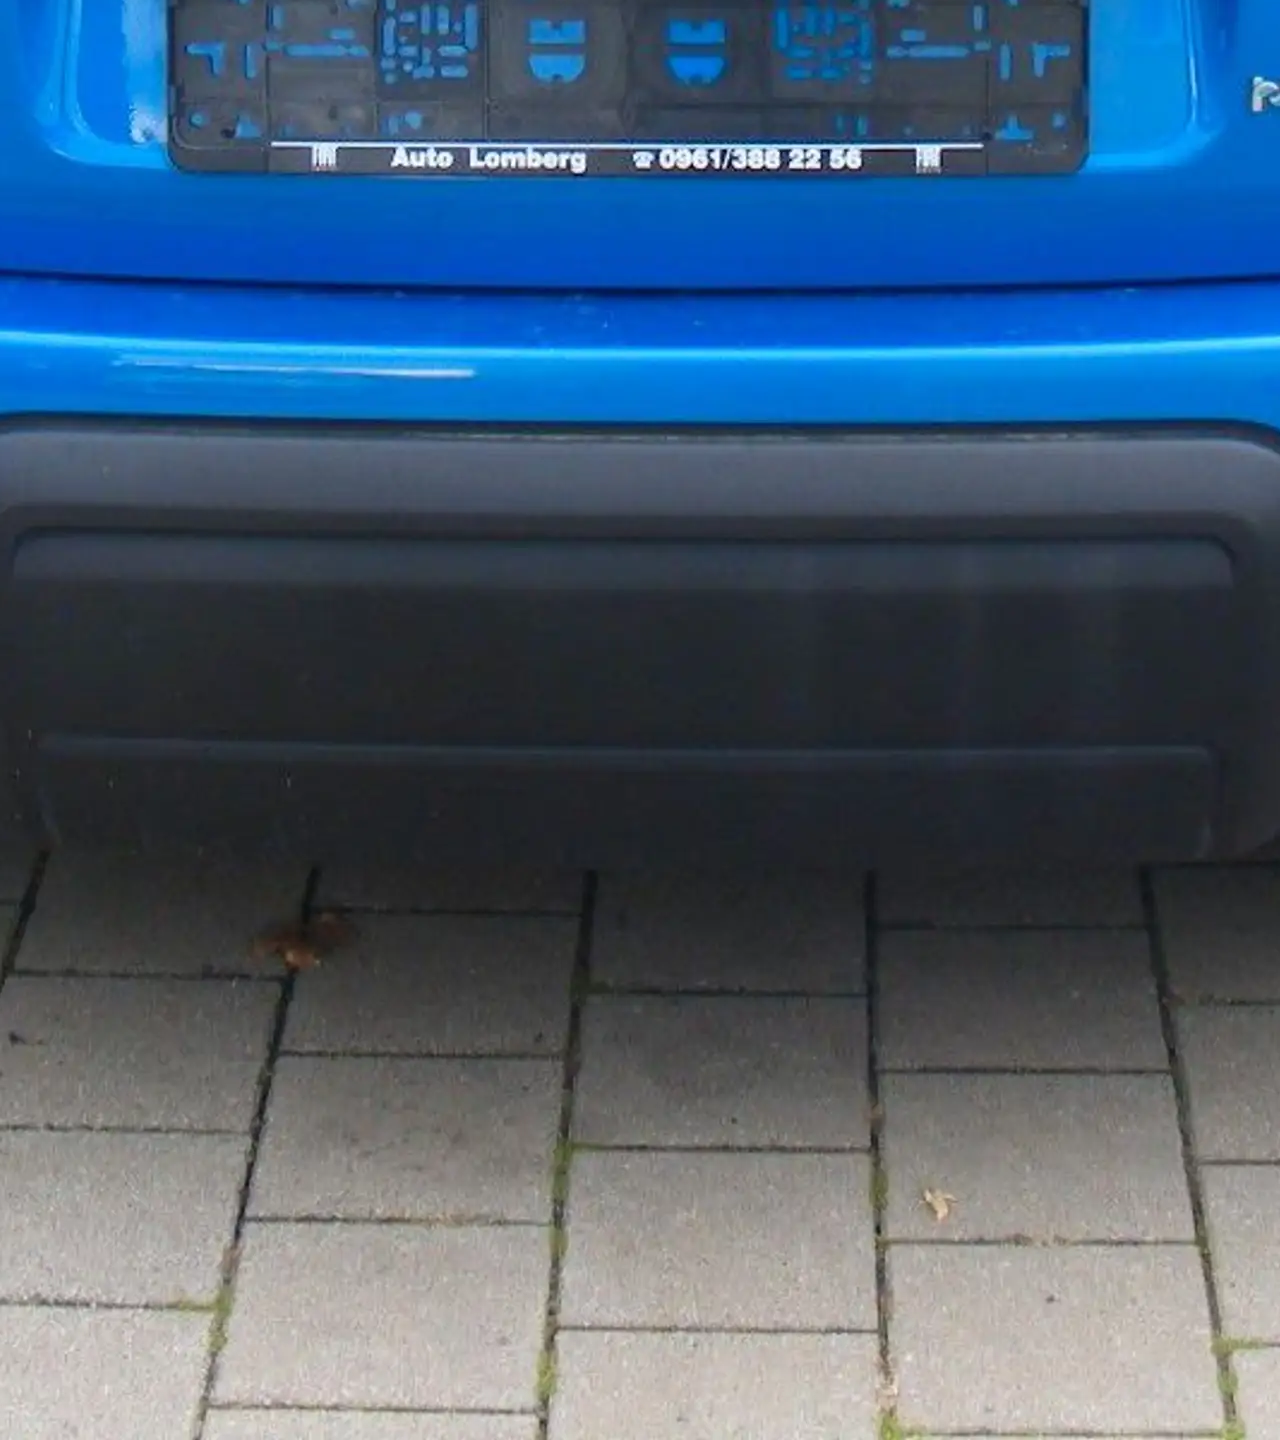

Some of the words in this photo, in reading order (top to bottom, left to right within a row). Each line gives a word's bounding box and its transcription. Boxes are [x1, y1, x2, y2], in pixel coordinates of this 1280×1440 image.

[390, 146, 455, 168] Auto
[470, 148, 587, 173] Lomberg
[788, 149, 821, 169] 22
